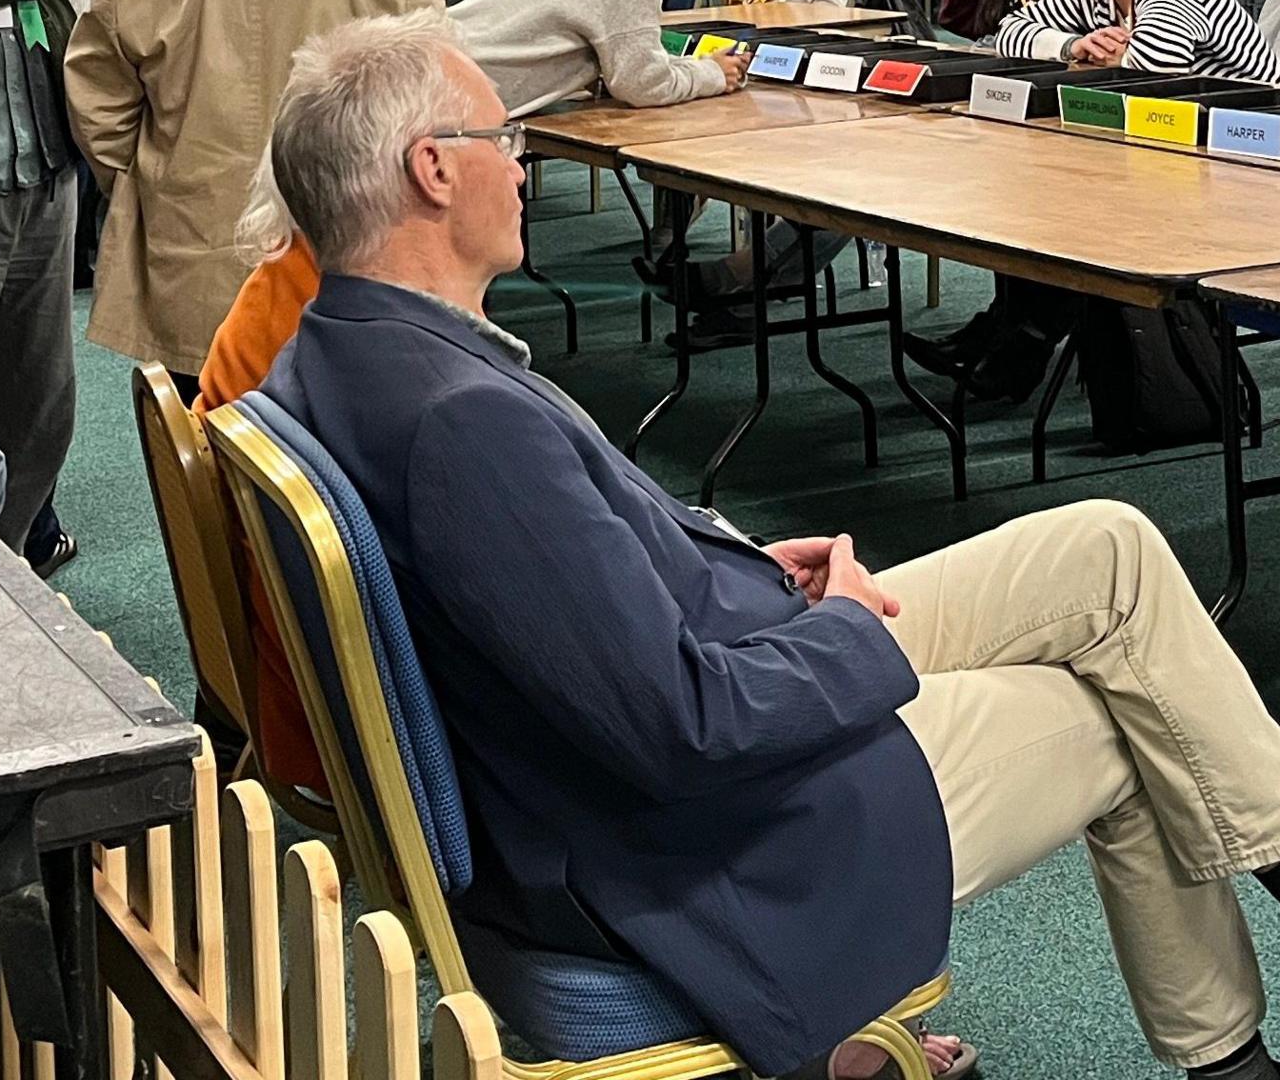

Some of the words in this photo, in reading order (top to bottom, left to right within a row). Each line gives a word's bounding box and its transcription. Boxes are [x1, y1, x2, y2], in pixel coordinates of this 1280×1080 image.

[985, 88, 1012, 103] SIKDER
[1068, 98, 1119, 116] MCFARLING
[1145, 111, 1175, 126] JOYCE
[1227, 125, 1265, 141] HARPER
